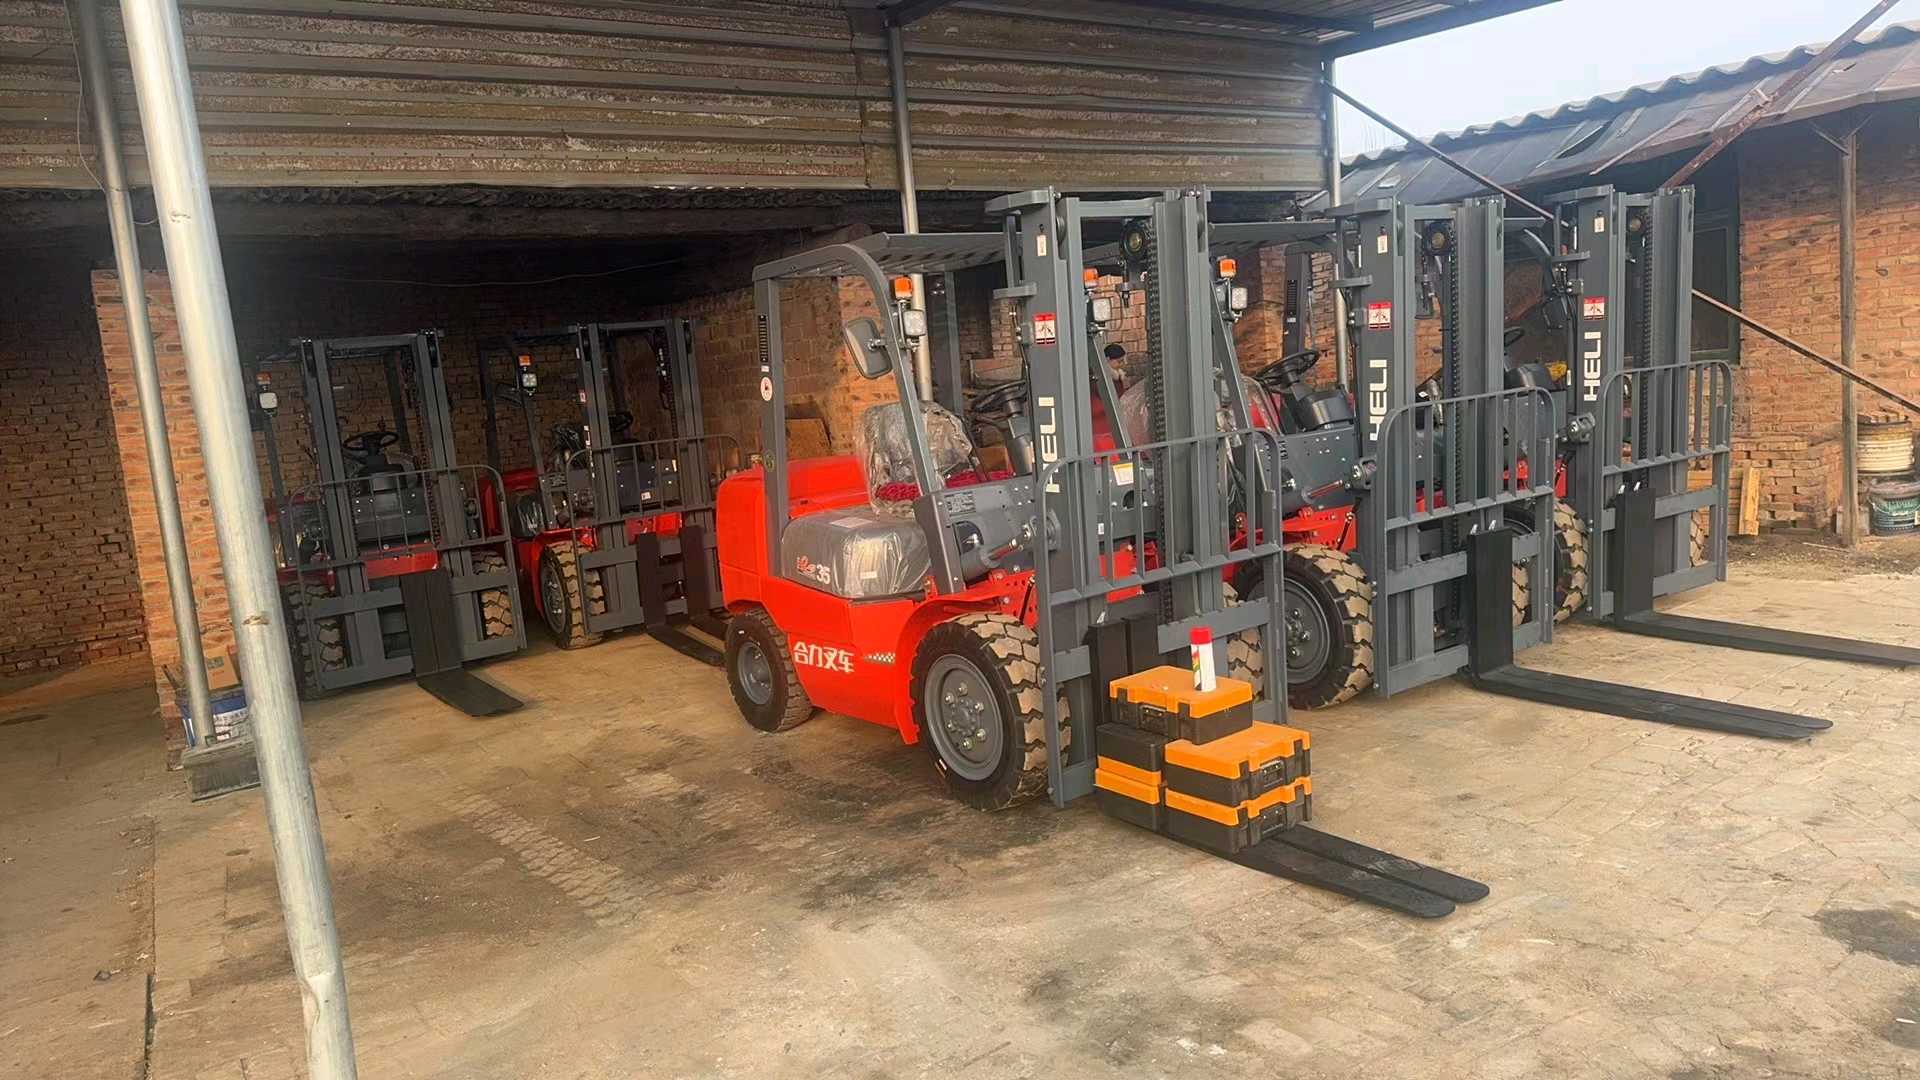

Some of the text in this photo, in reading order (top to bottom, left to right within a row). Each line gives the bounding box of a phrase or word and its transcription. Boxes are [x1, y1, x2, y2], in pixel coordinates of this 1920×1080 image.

[1583, 331, 1601, 401] HELI
[816, 563, 831, 585] 35
[793, 641, 855, 673] 合力叉车
